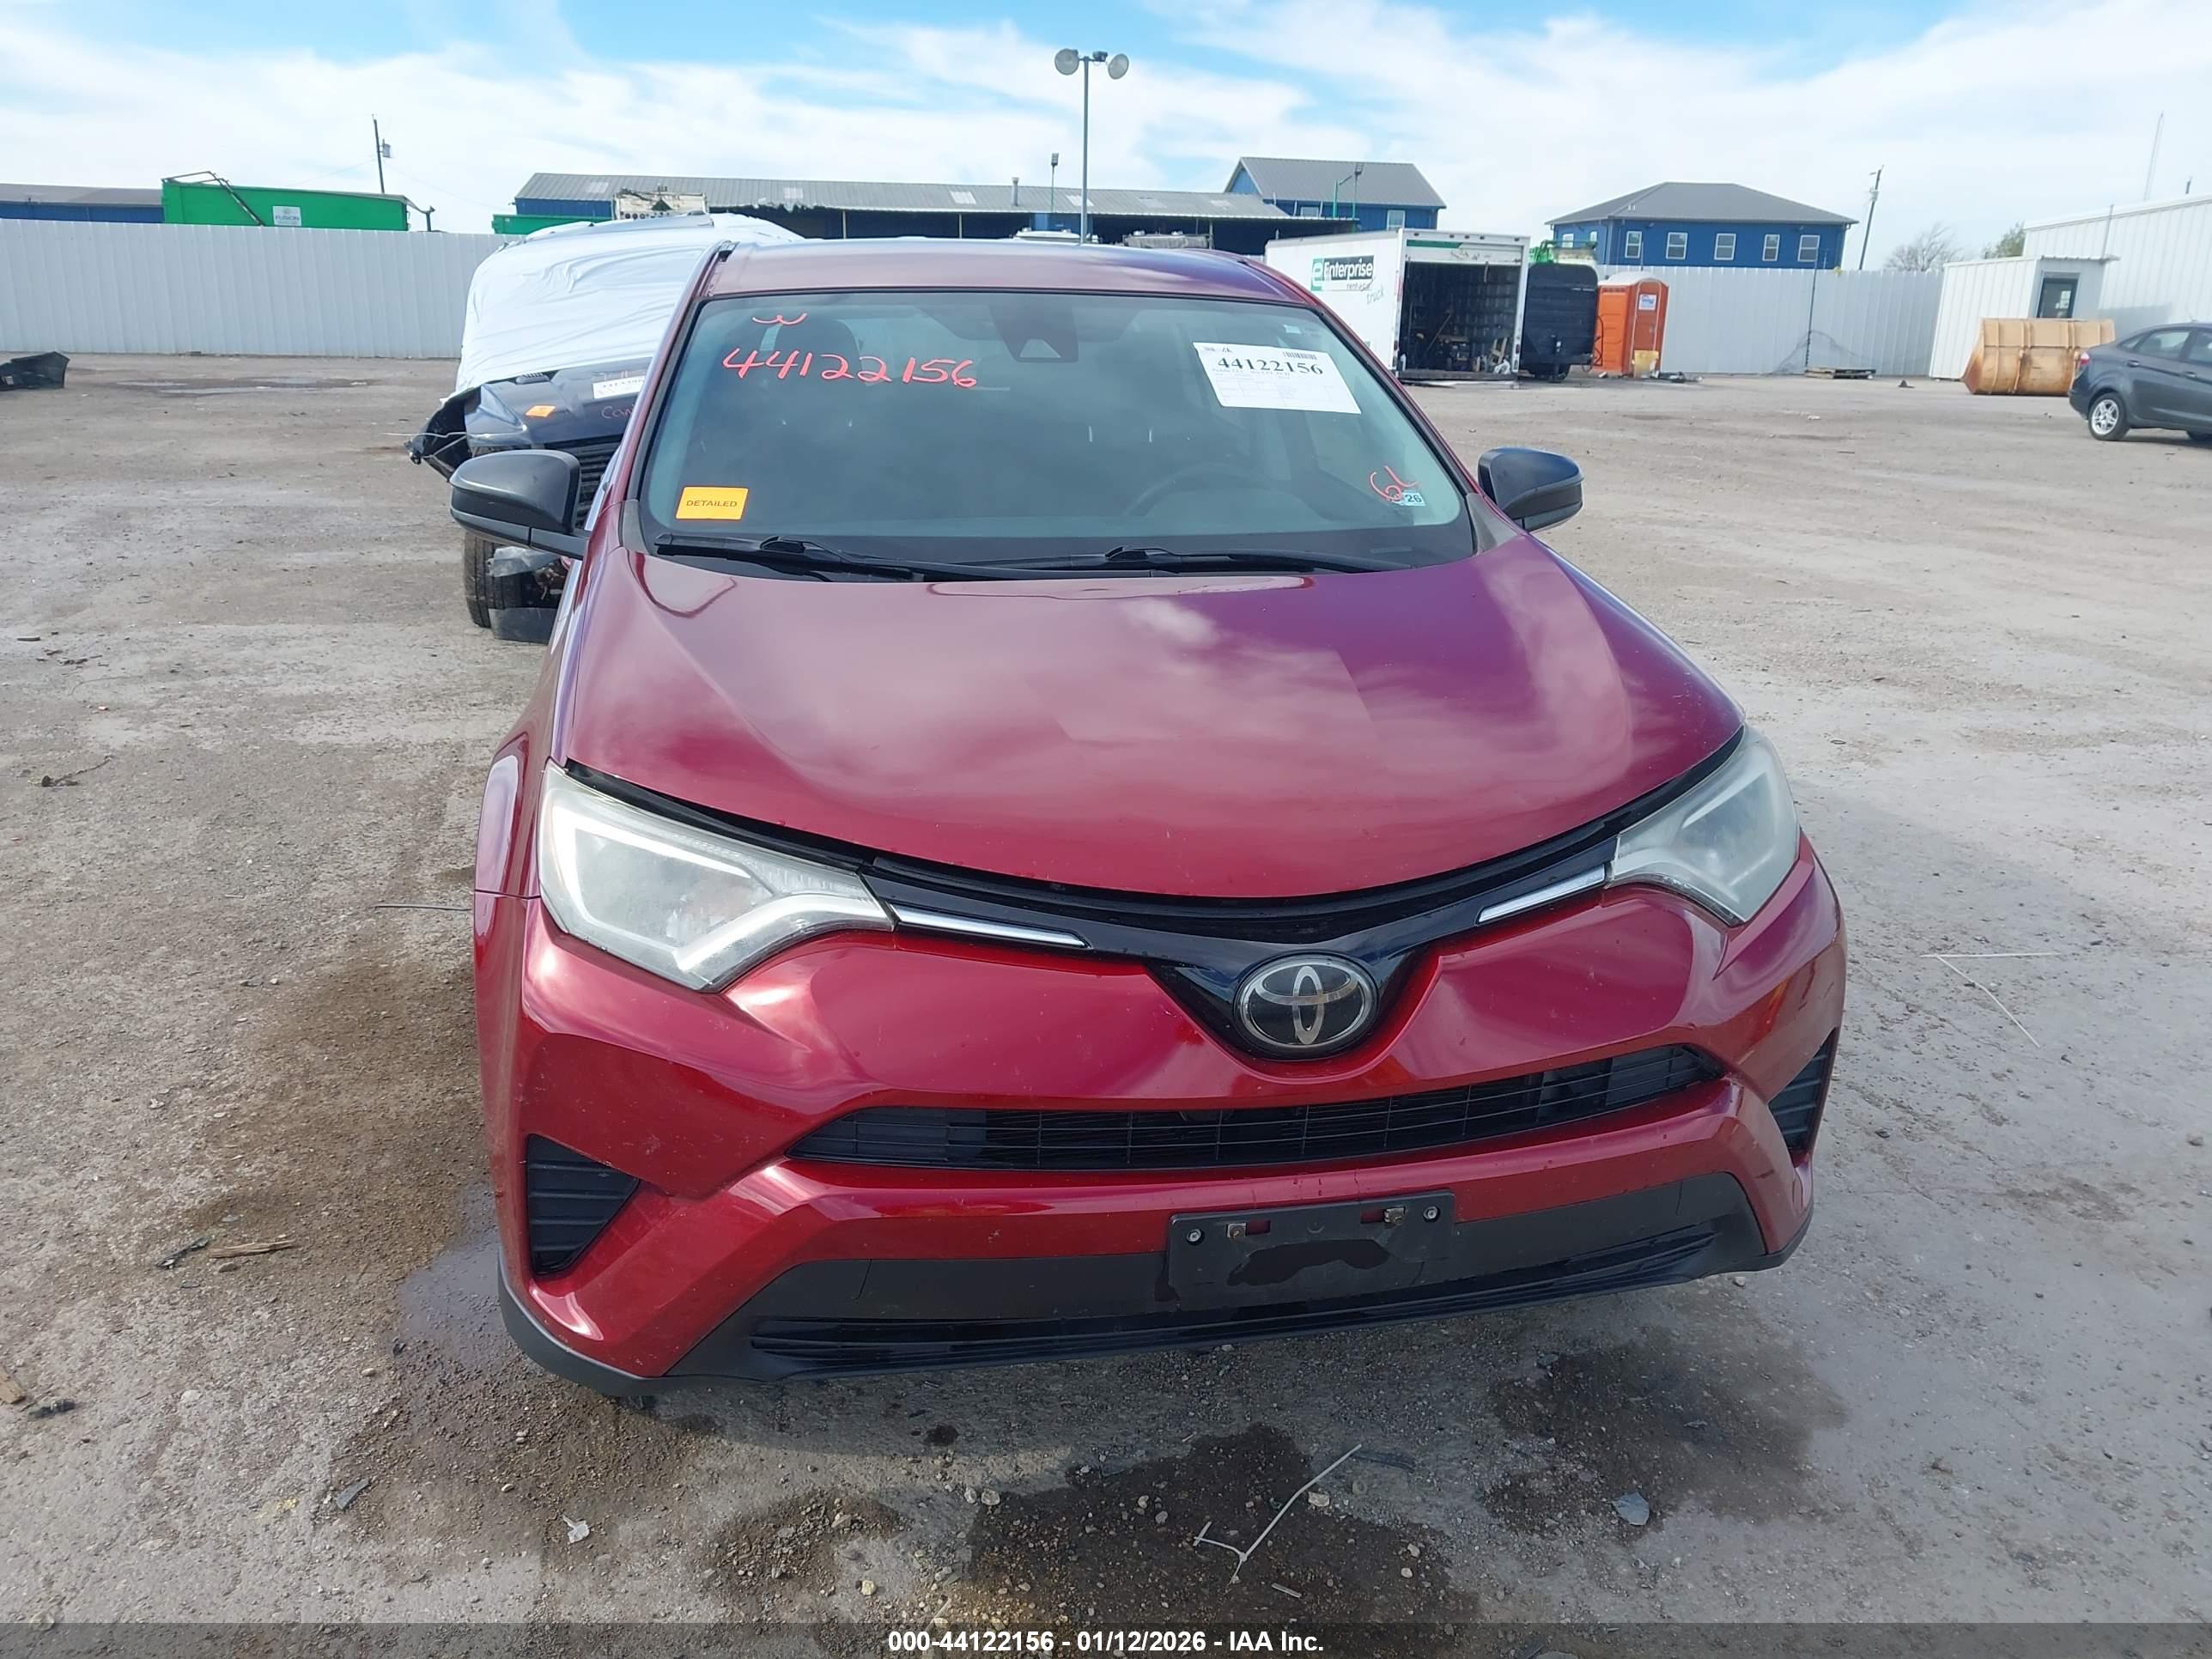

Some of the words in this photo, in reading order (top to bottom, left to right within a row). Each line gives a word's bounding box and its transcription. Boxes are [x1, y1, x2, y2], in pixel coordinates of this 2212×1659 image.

[1323, 258, 1374, 281] Enterprise
[722, 348, 977, 387] 44122156
[1217, 356, 1323, 375] 44122156
[1404, 494, 1423, 503] 26
